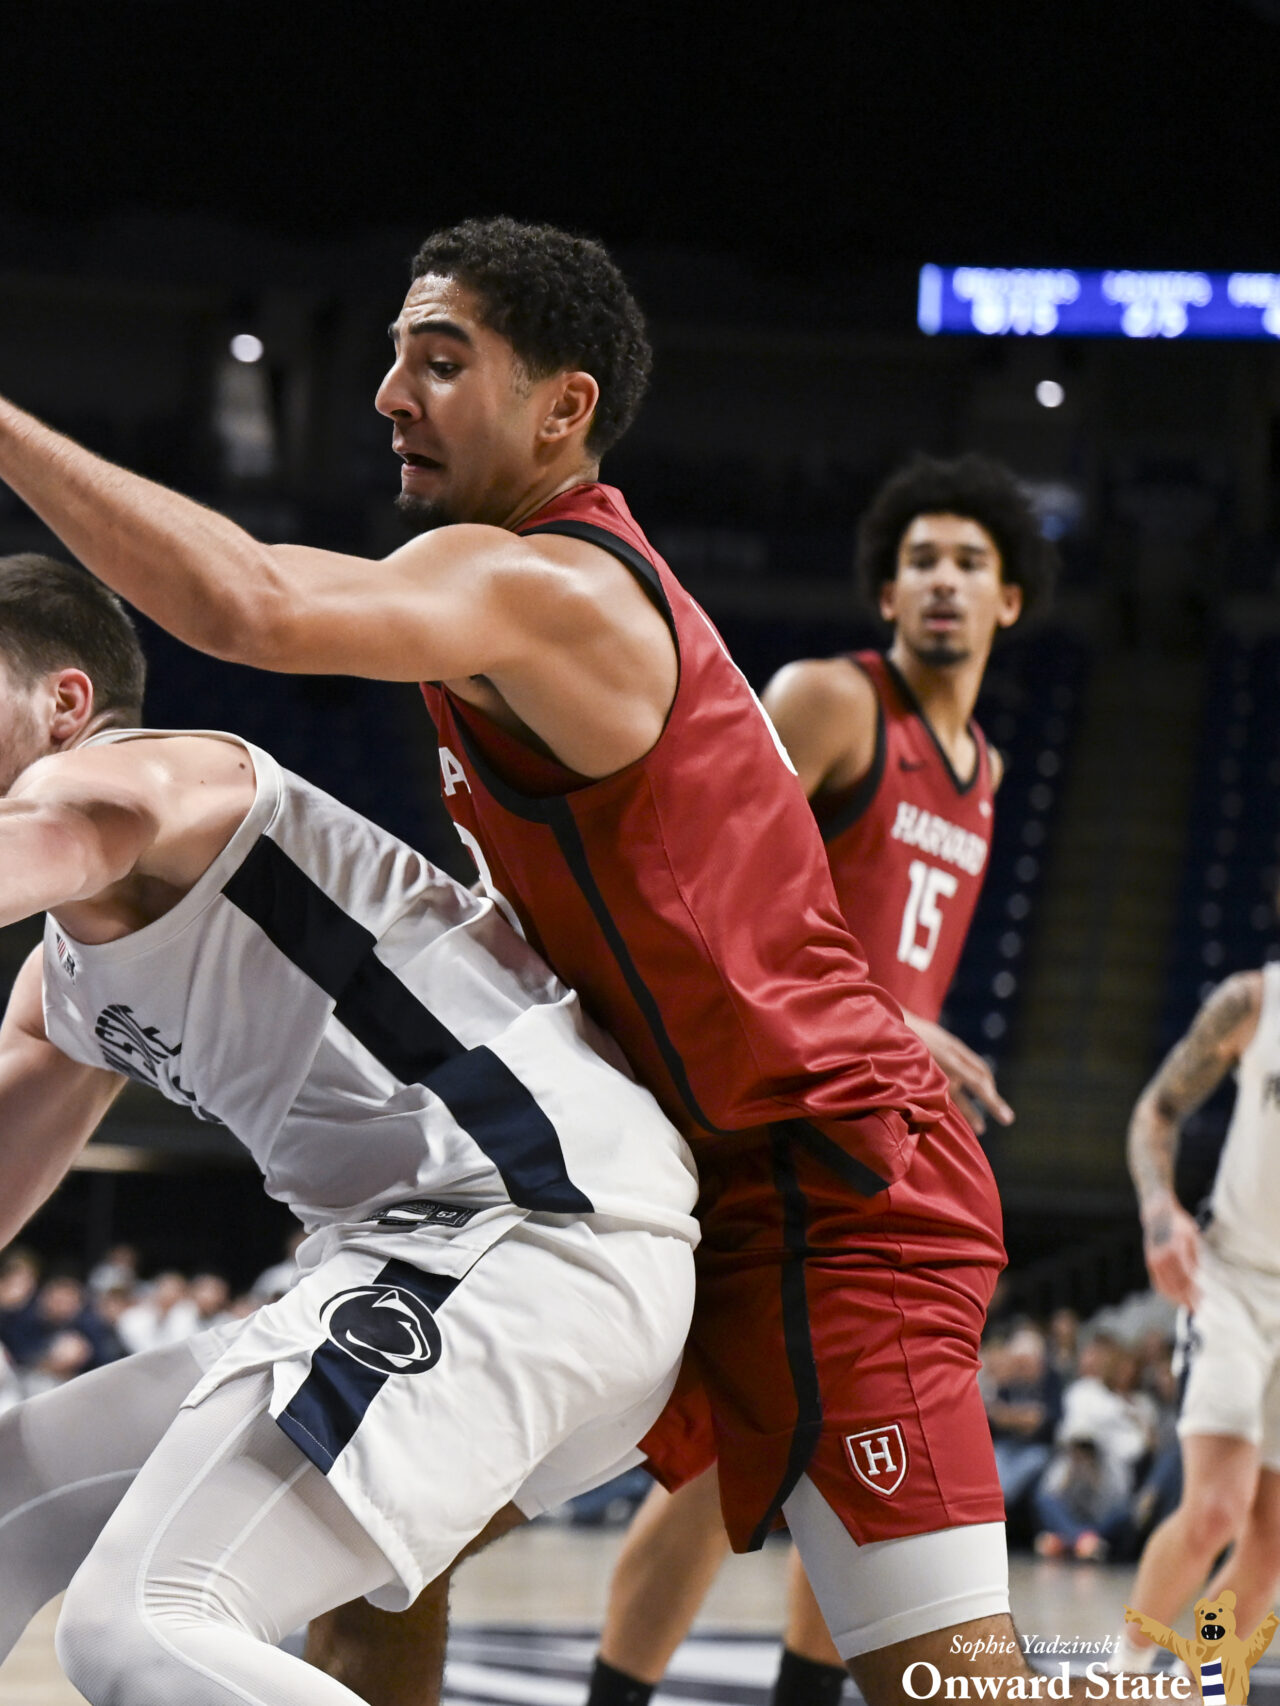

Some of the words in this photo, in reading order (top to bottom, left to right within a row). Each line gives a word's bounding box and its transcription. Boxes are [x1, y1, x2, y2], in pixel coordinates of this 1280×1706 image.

[891, 801, 988, 876] HARVARD
[896, 859, 958, 972] 15
[860, 1436, 897, 1476] H
